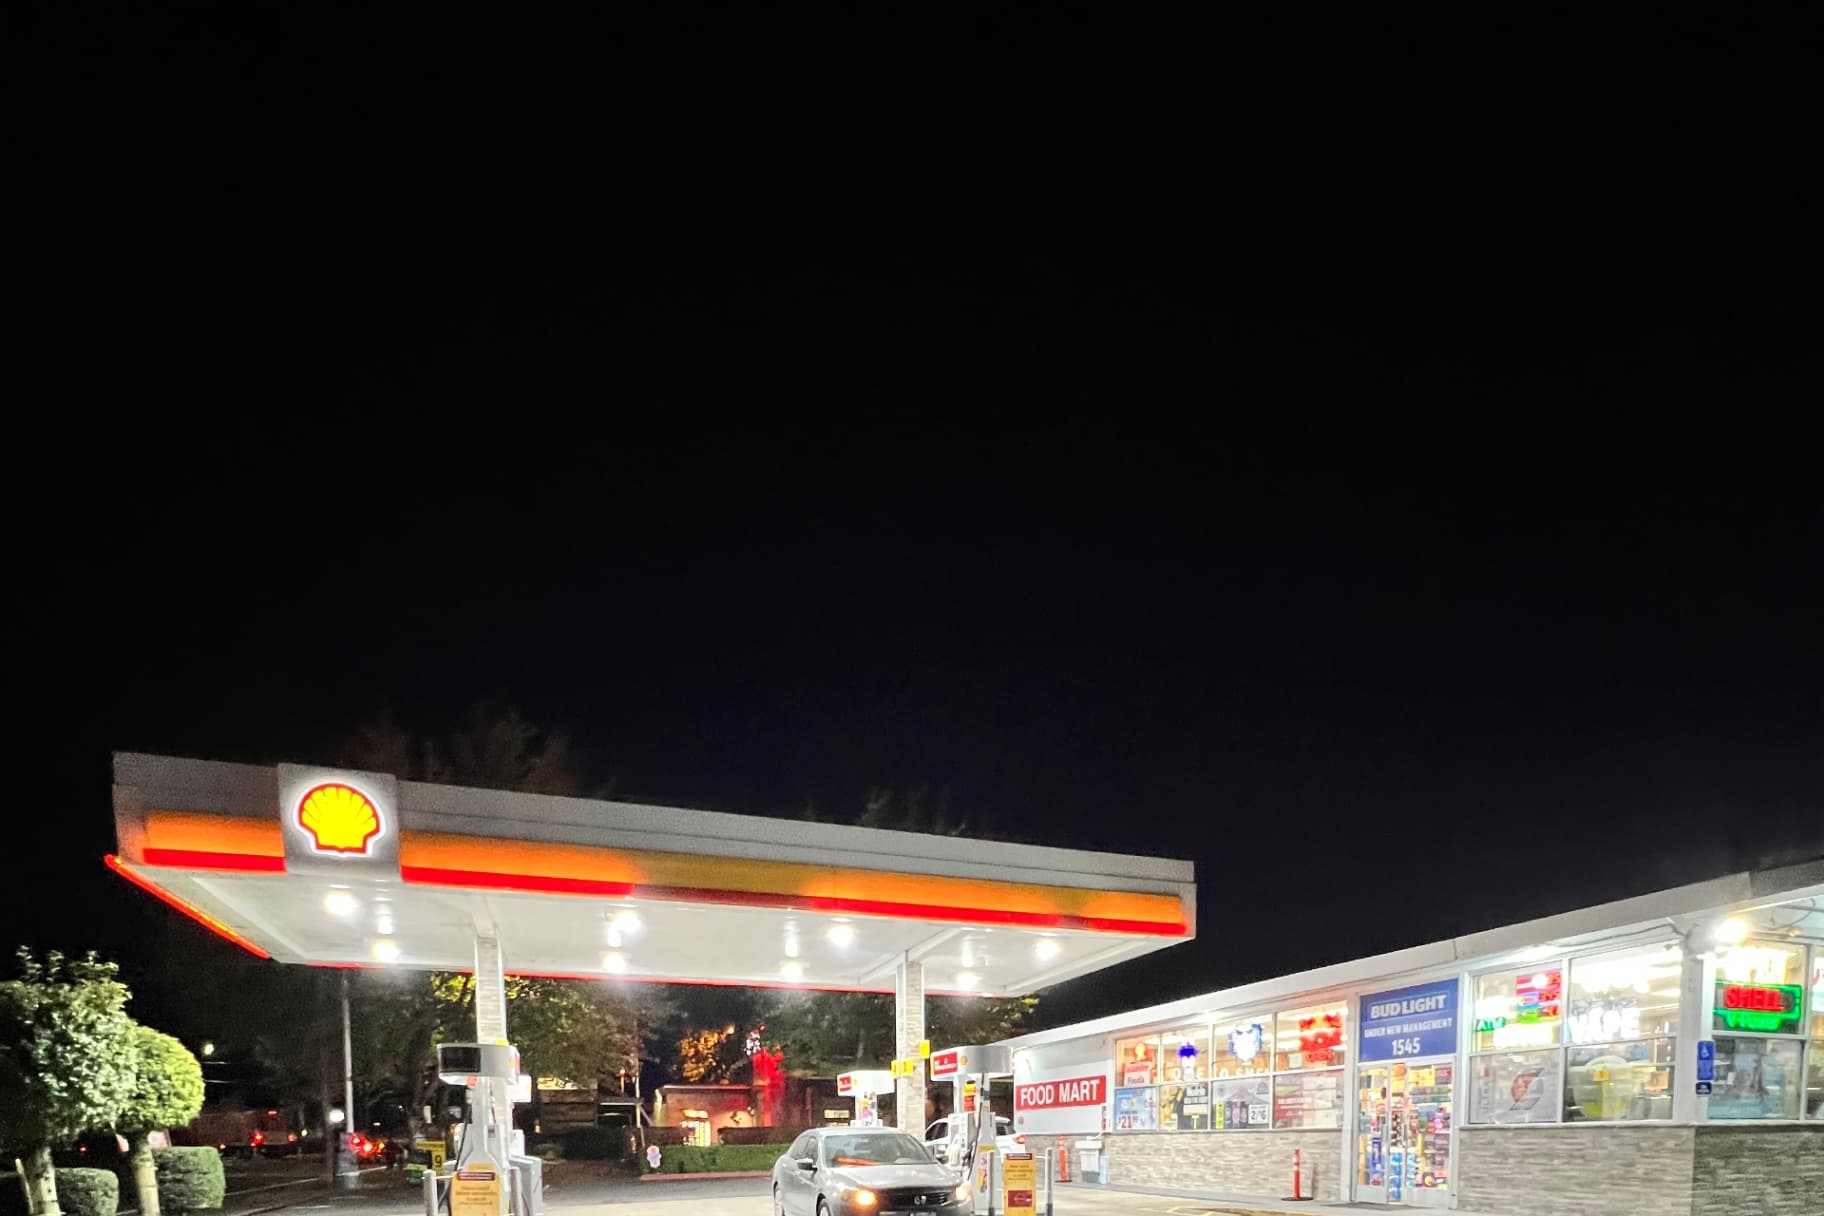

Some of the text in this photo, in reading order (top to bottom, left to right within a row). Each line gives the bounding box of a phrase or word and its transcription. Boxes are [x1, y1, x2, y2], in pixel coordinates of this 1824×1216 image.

[1370, 994, 1447, 1019] BUD LIGHT
[1724, 985, 1784, 1012] SHELL
[1364, 1018, 1453, 1038] UNDER NEW MANAGEMENT
[1568, 1007, 1640, 1043] VAPE
[1391, 1037, 1421, 1056] 1545
[1020, 1079, 1100, 1107] FOOD MART
